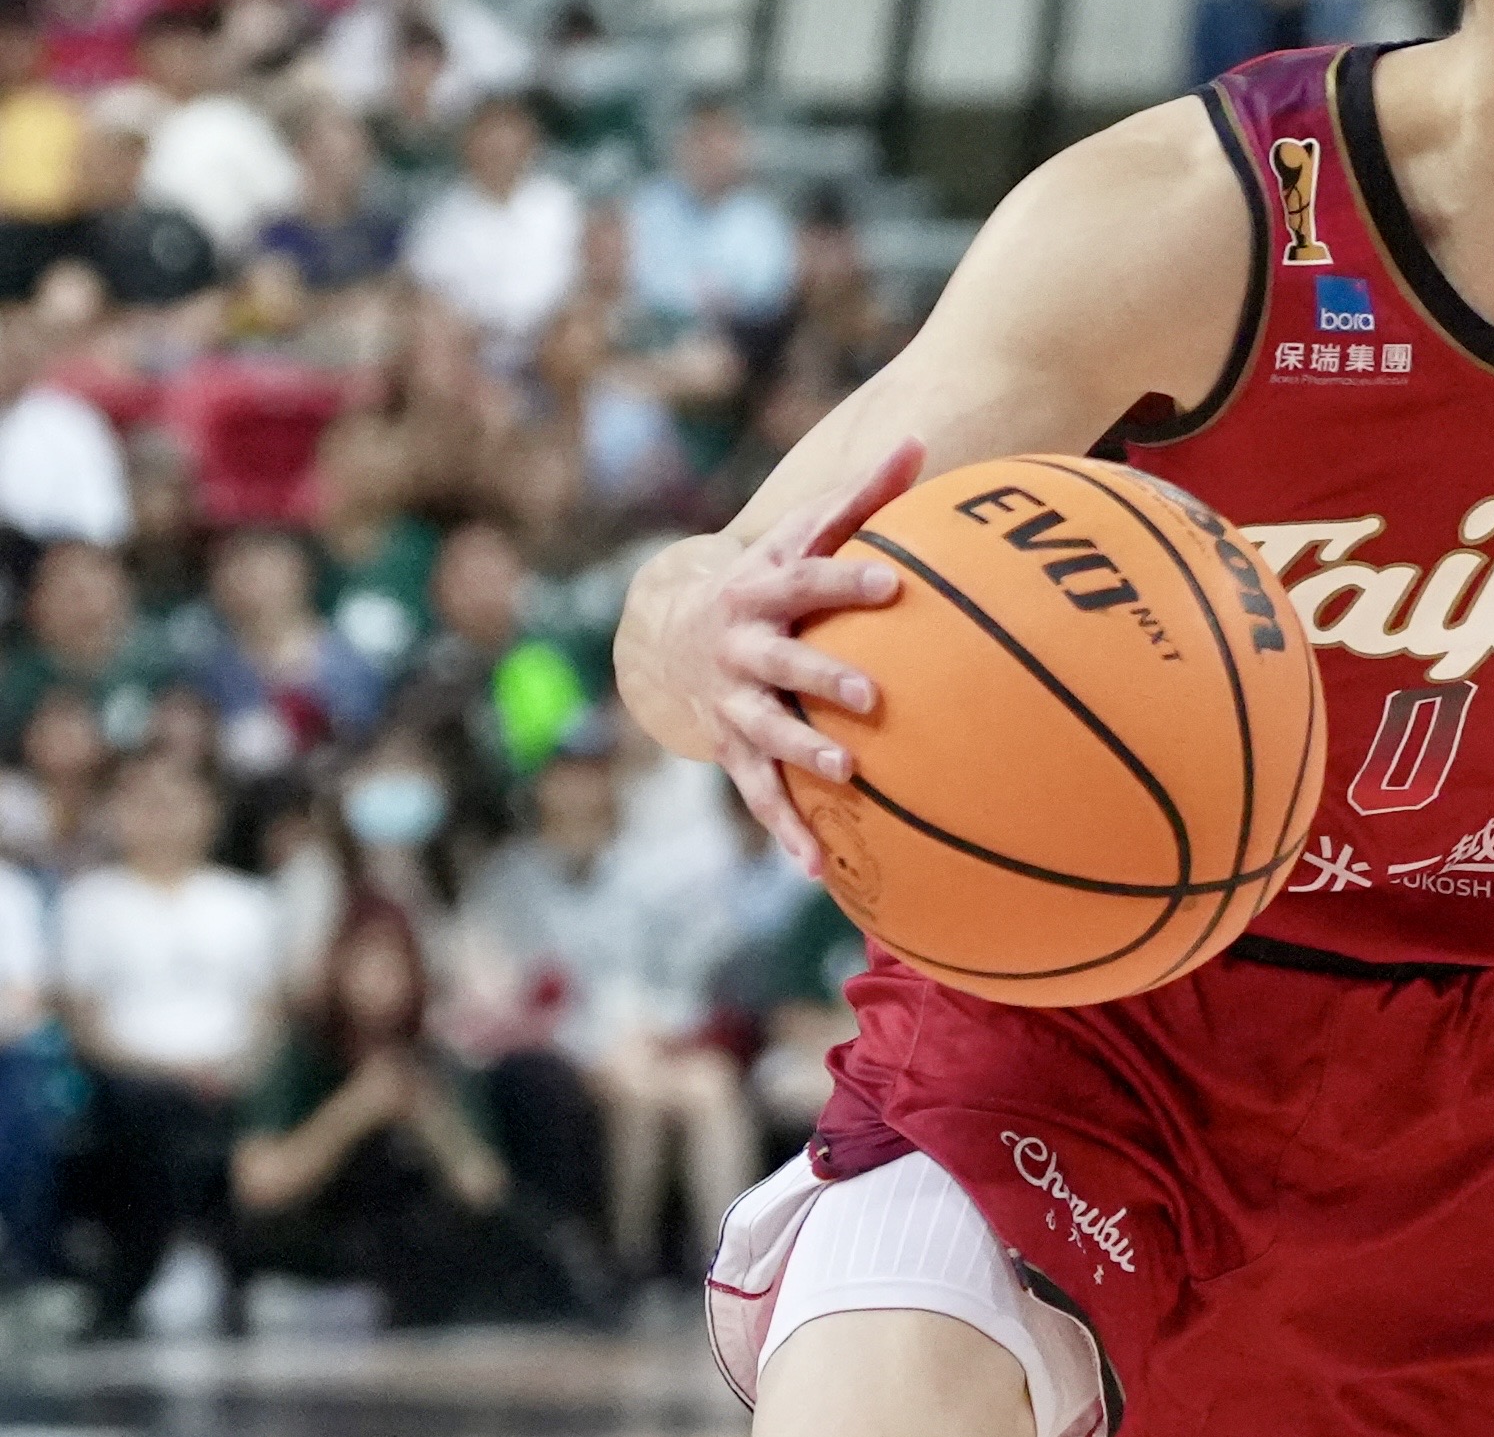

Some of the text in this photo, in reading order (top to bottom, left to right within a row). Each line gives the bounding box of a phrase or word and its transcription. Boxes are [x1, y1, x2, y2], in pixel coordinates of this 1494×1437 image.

[1319, 307, 1376, 331] bora
[1274, 342, 1413, 373] 保瑞集團
[954, 486, 1140, 611] EVO
[1130, 607, 1184, 662] NXT
[1346, 679, 1479, 816] 0
